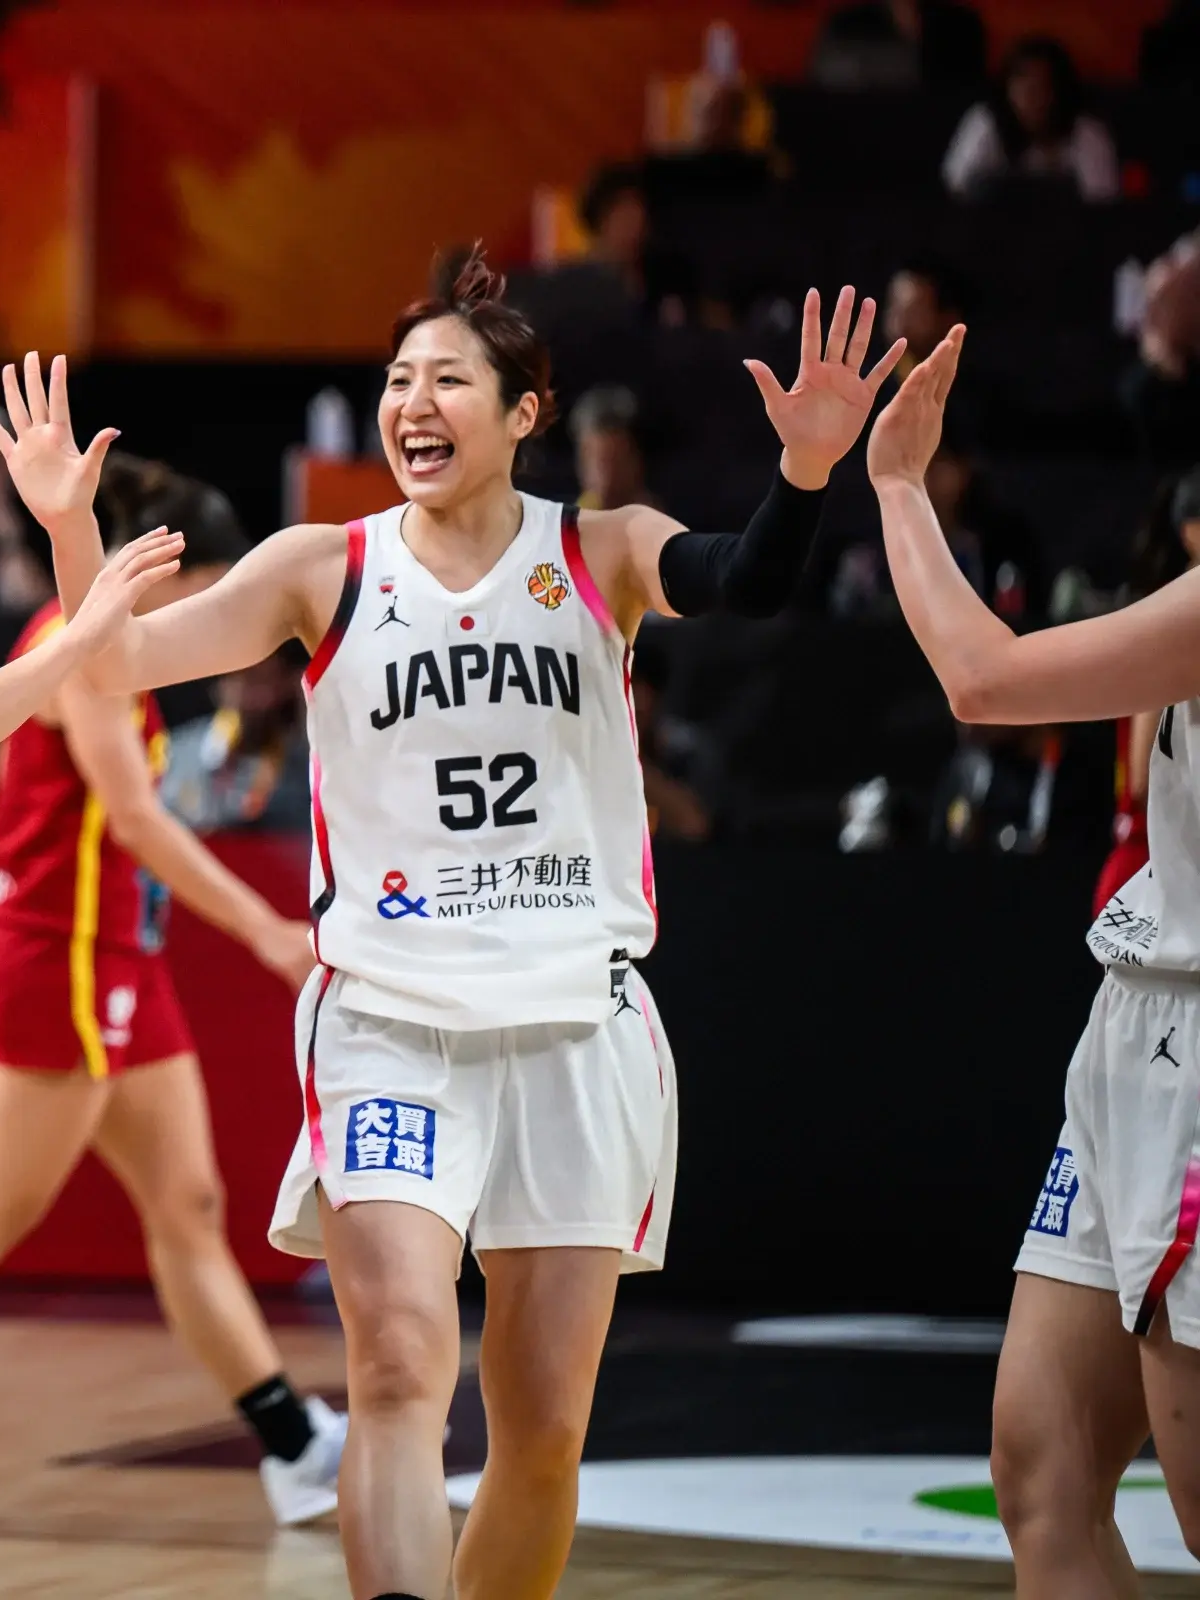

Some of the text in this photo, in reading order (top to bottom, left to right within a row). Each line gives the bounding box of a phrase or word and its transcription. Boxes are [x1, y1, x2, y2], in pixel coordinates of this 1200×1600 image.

[370, 643, 580, 731] JAPAN
[435, 752, 537, 831] 52
[436, 854, 592, 897] 三井不動産
[437, 894, 508, 918] MITSUI
[509, 892, 596, 910] FUDOSAN
